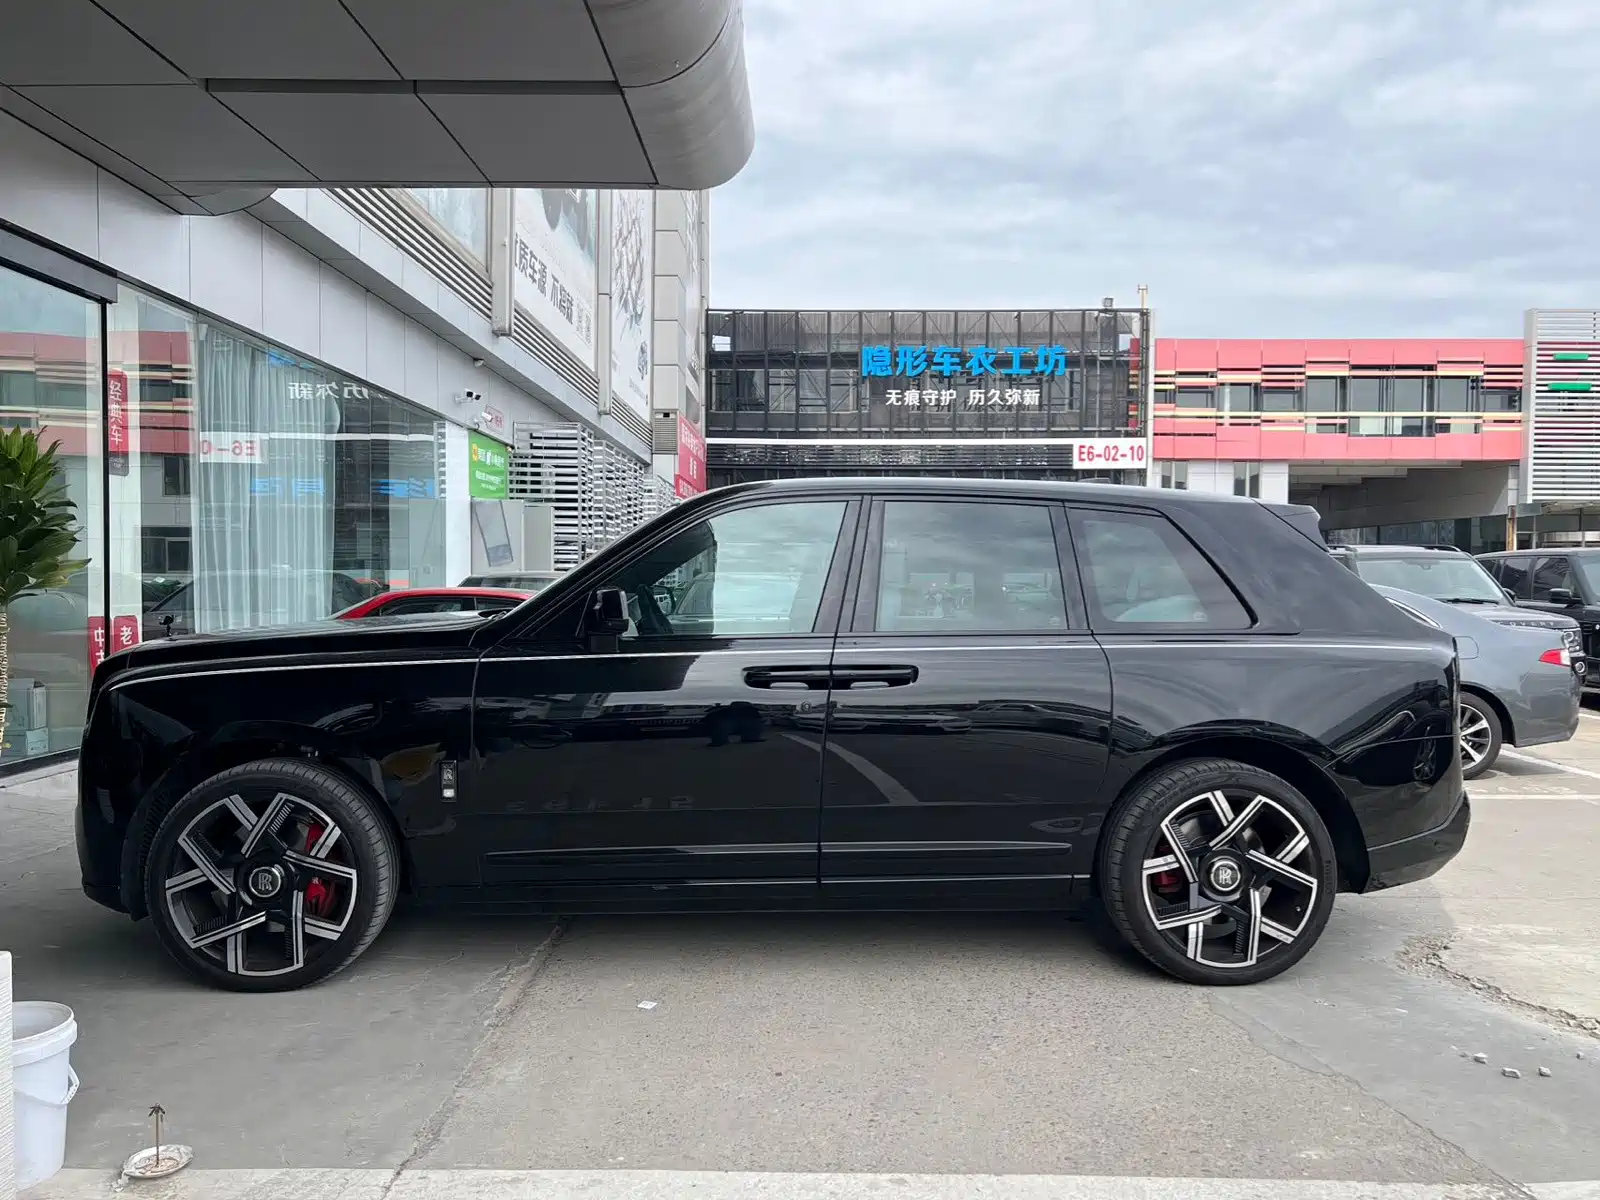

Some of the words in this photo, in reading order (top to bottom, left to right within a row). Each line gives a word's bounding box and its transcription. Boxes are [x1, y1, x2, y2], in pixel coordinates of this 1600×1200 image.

[515, 233, 547, 297] 质车源
[861, 345, 1067, 377] 隐形车衣工坊
[885, 389, 957, 406] 无痕守护
[968, 389, 1040, 406] 历久弥新
[110, 380, 122, 445] 经典车
[1078, 445, 1145, 462] E6-02-10
[120, 625, 133, 645] 老
